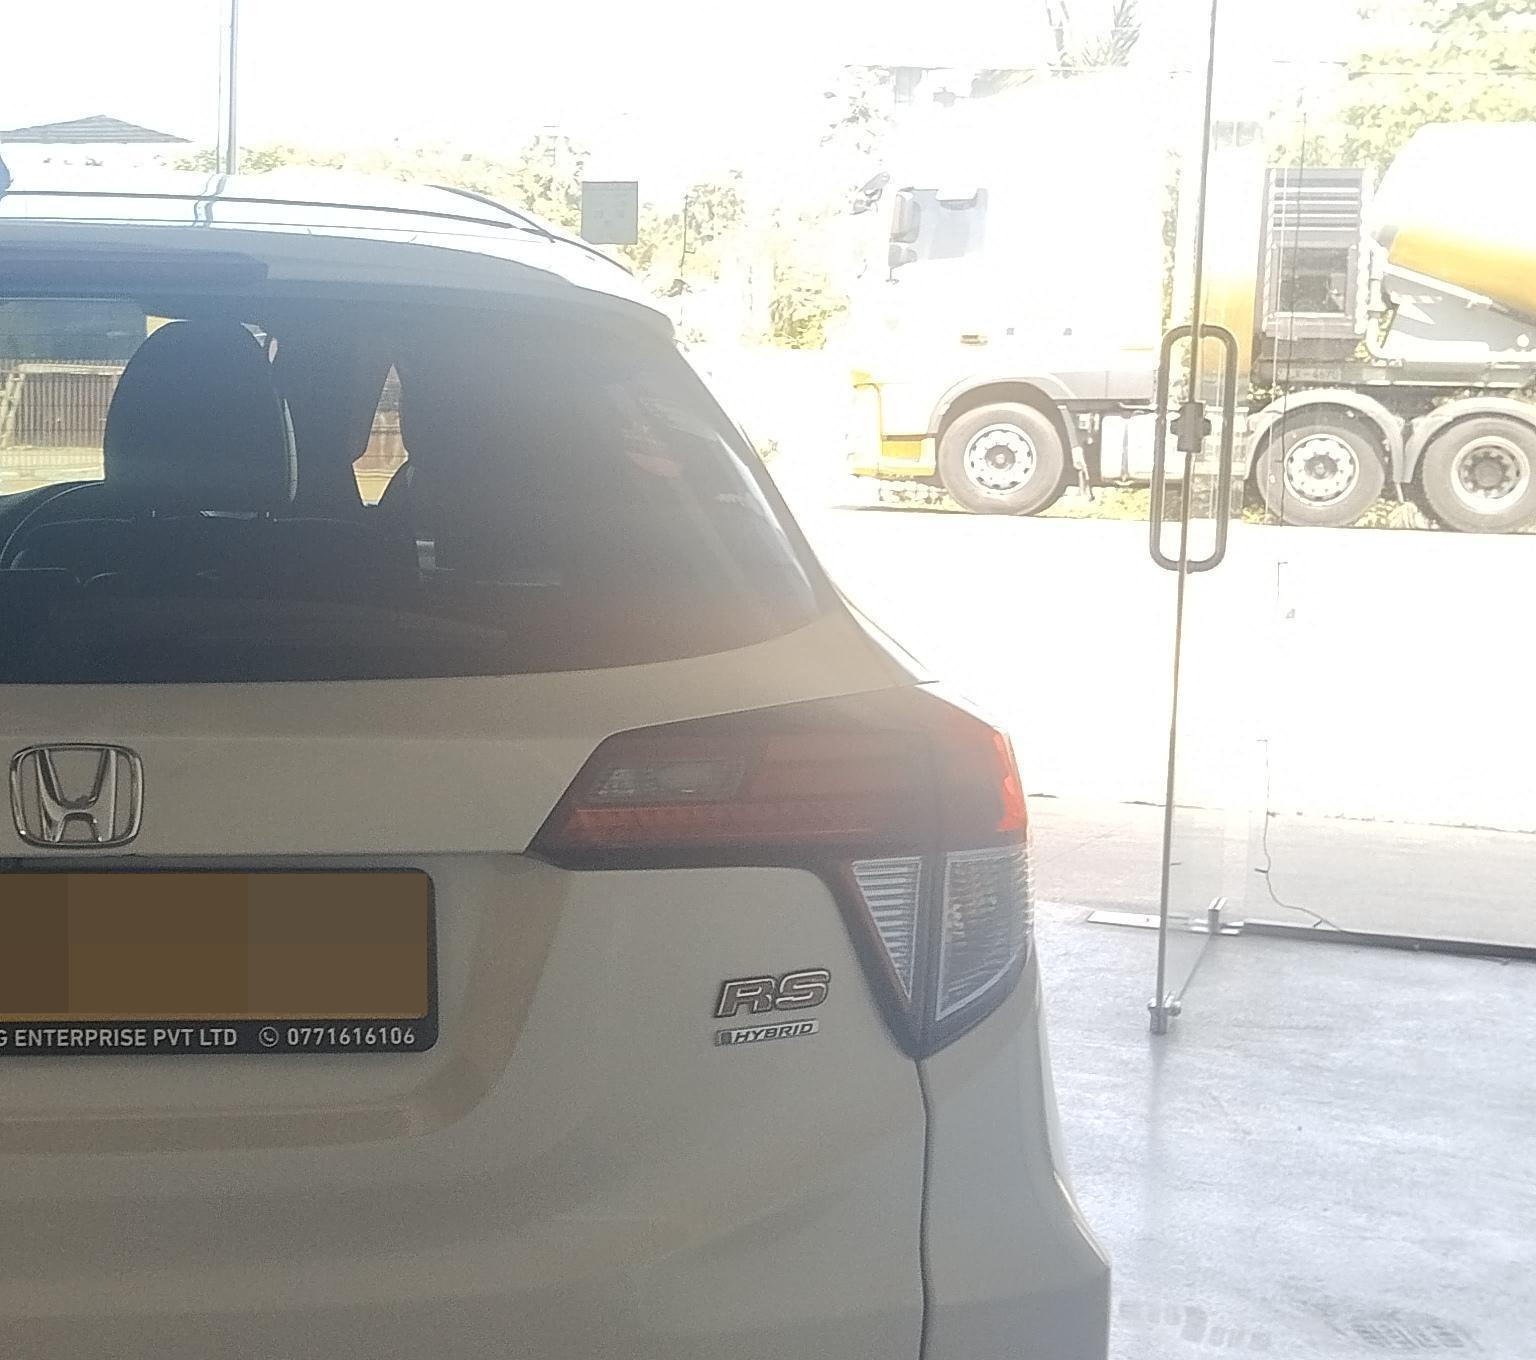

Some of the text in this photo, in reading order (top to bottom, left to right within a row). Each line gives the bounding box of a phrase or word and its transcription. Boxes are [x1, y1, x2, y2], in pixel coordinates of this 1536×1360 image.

[713, 968, 831, 1018] RS
[15, 1029, 147, 1048] ENTERPRISE
[152, 1028, 194, 1047] PVT
[198, 1028, 238, 1047] LTD
[286, 1027, 416, 1047] 0771616106
[734, 1022, 814, 1044] HYBRID
